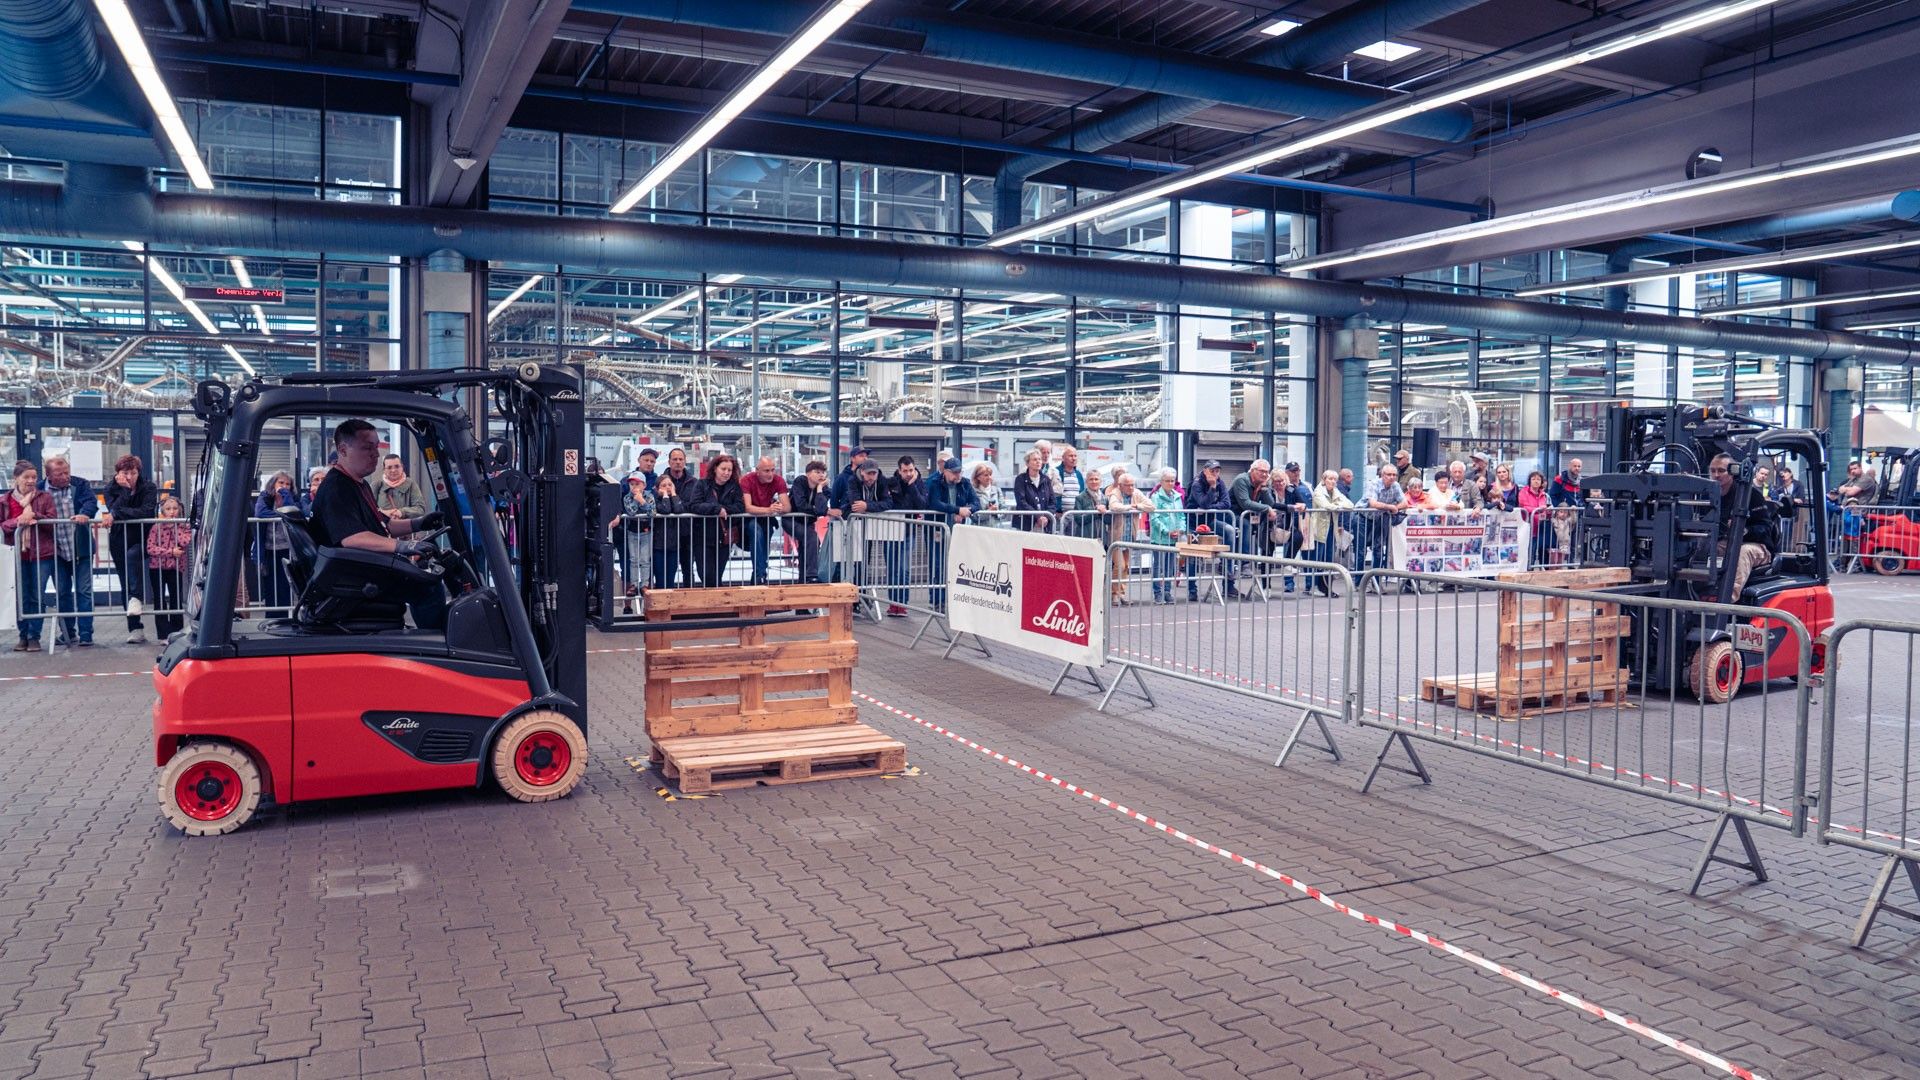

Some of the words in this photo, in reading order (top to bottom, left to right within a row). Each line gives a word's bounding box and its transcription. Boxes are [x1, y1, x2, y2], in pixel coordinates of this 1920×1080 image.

[216, 287, 260, 296] Chemnitzer
[550, 390, 580, 400] Linde
[1025, 556, 1037, 566] Linde
[1037, 558, 1055, 569] Material
[1055, 560, 1075, 574] Handling
[1032, 599, 1086, 637] Linde
[382, 717, 420, 729] Linde
